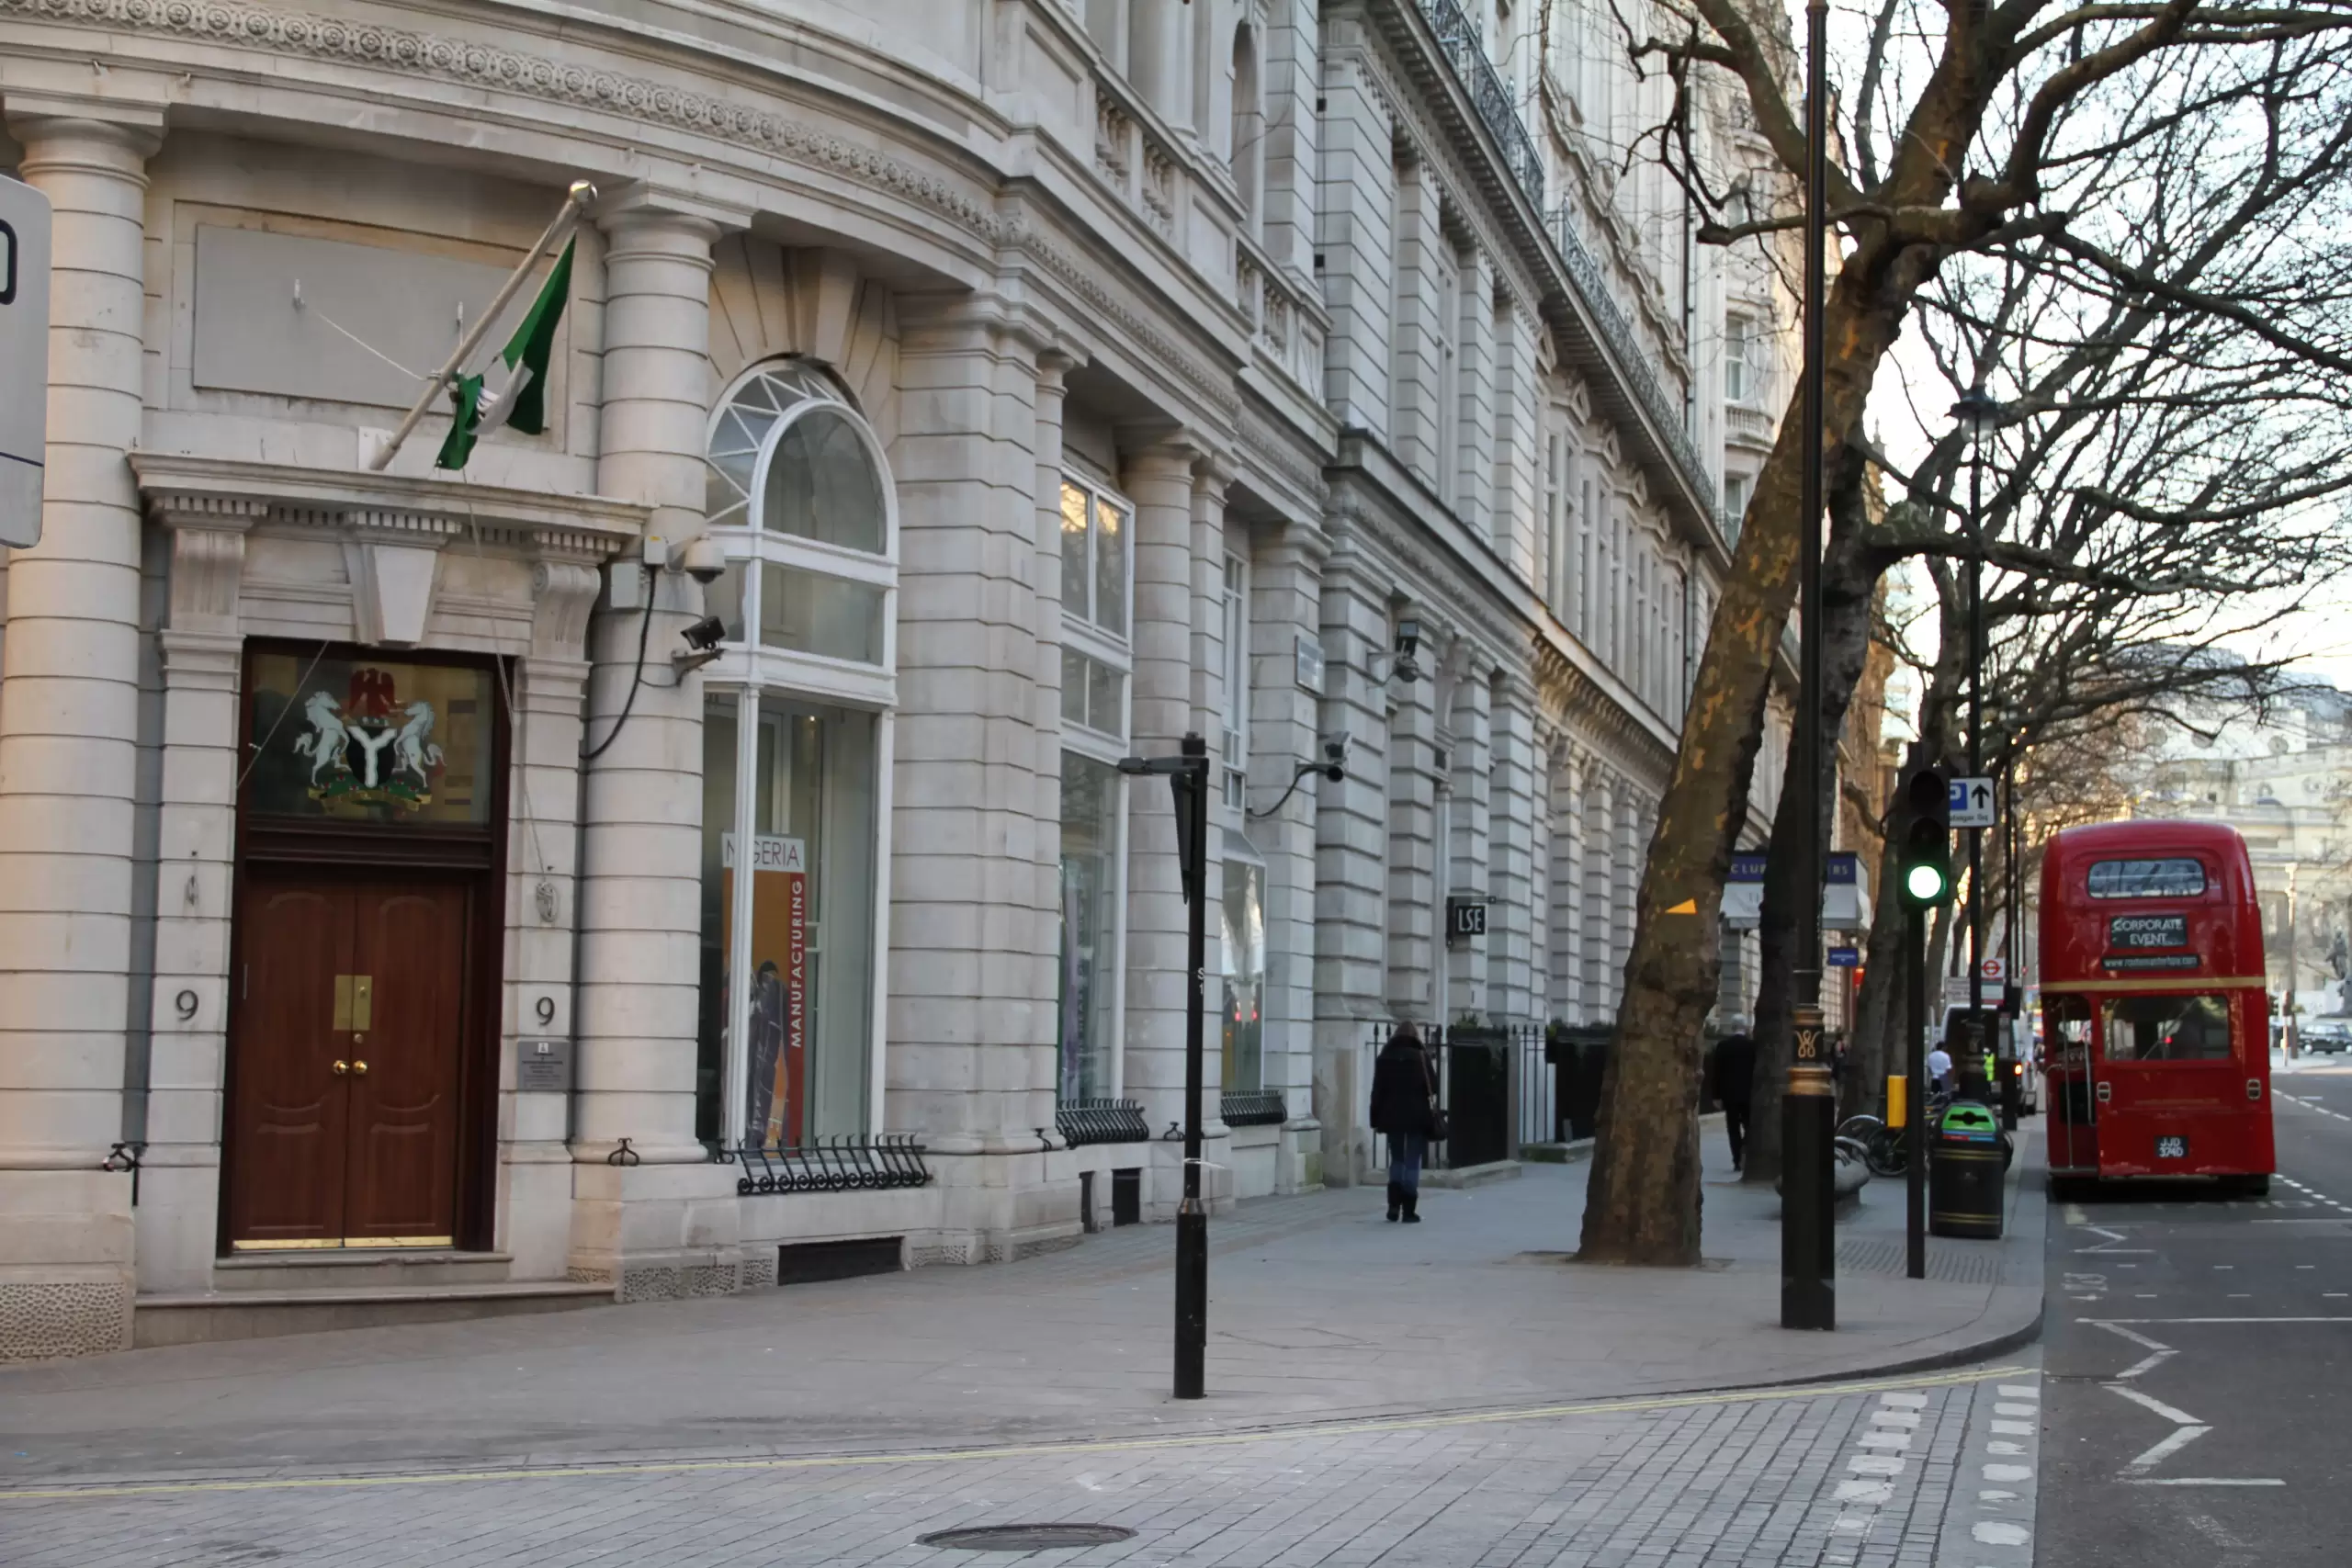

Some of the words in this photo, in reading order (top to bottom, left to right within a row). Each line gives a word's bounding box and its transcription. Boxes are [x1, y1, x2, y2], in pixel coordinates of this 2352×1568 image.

[727, 839, 800, 867] NGERIA
[1458, 908, 1482, 931] LSE
[2112, 919, 2183, 931] CORPORATE
[2130, 933, 2168, 945] EVENT
[791, 880, 802, 1047] MANUFACTURING
[176, 989, 198, 1021] 9
[536, 997, 555, 1025] 9
